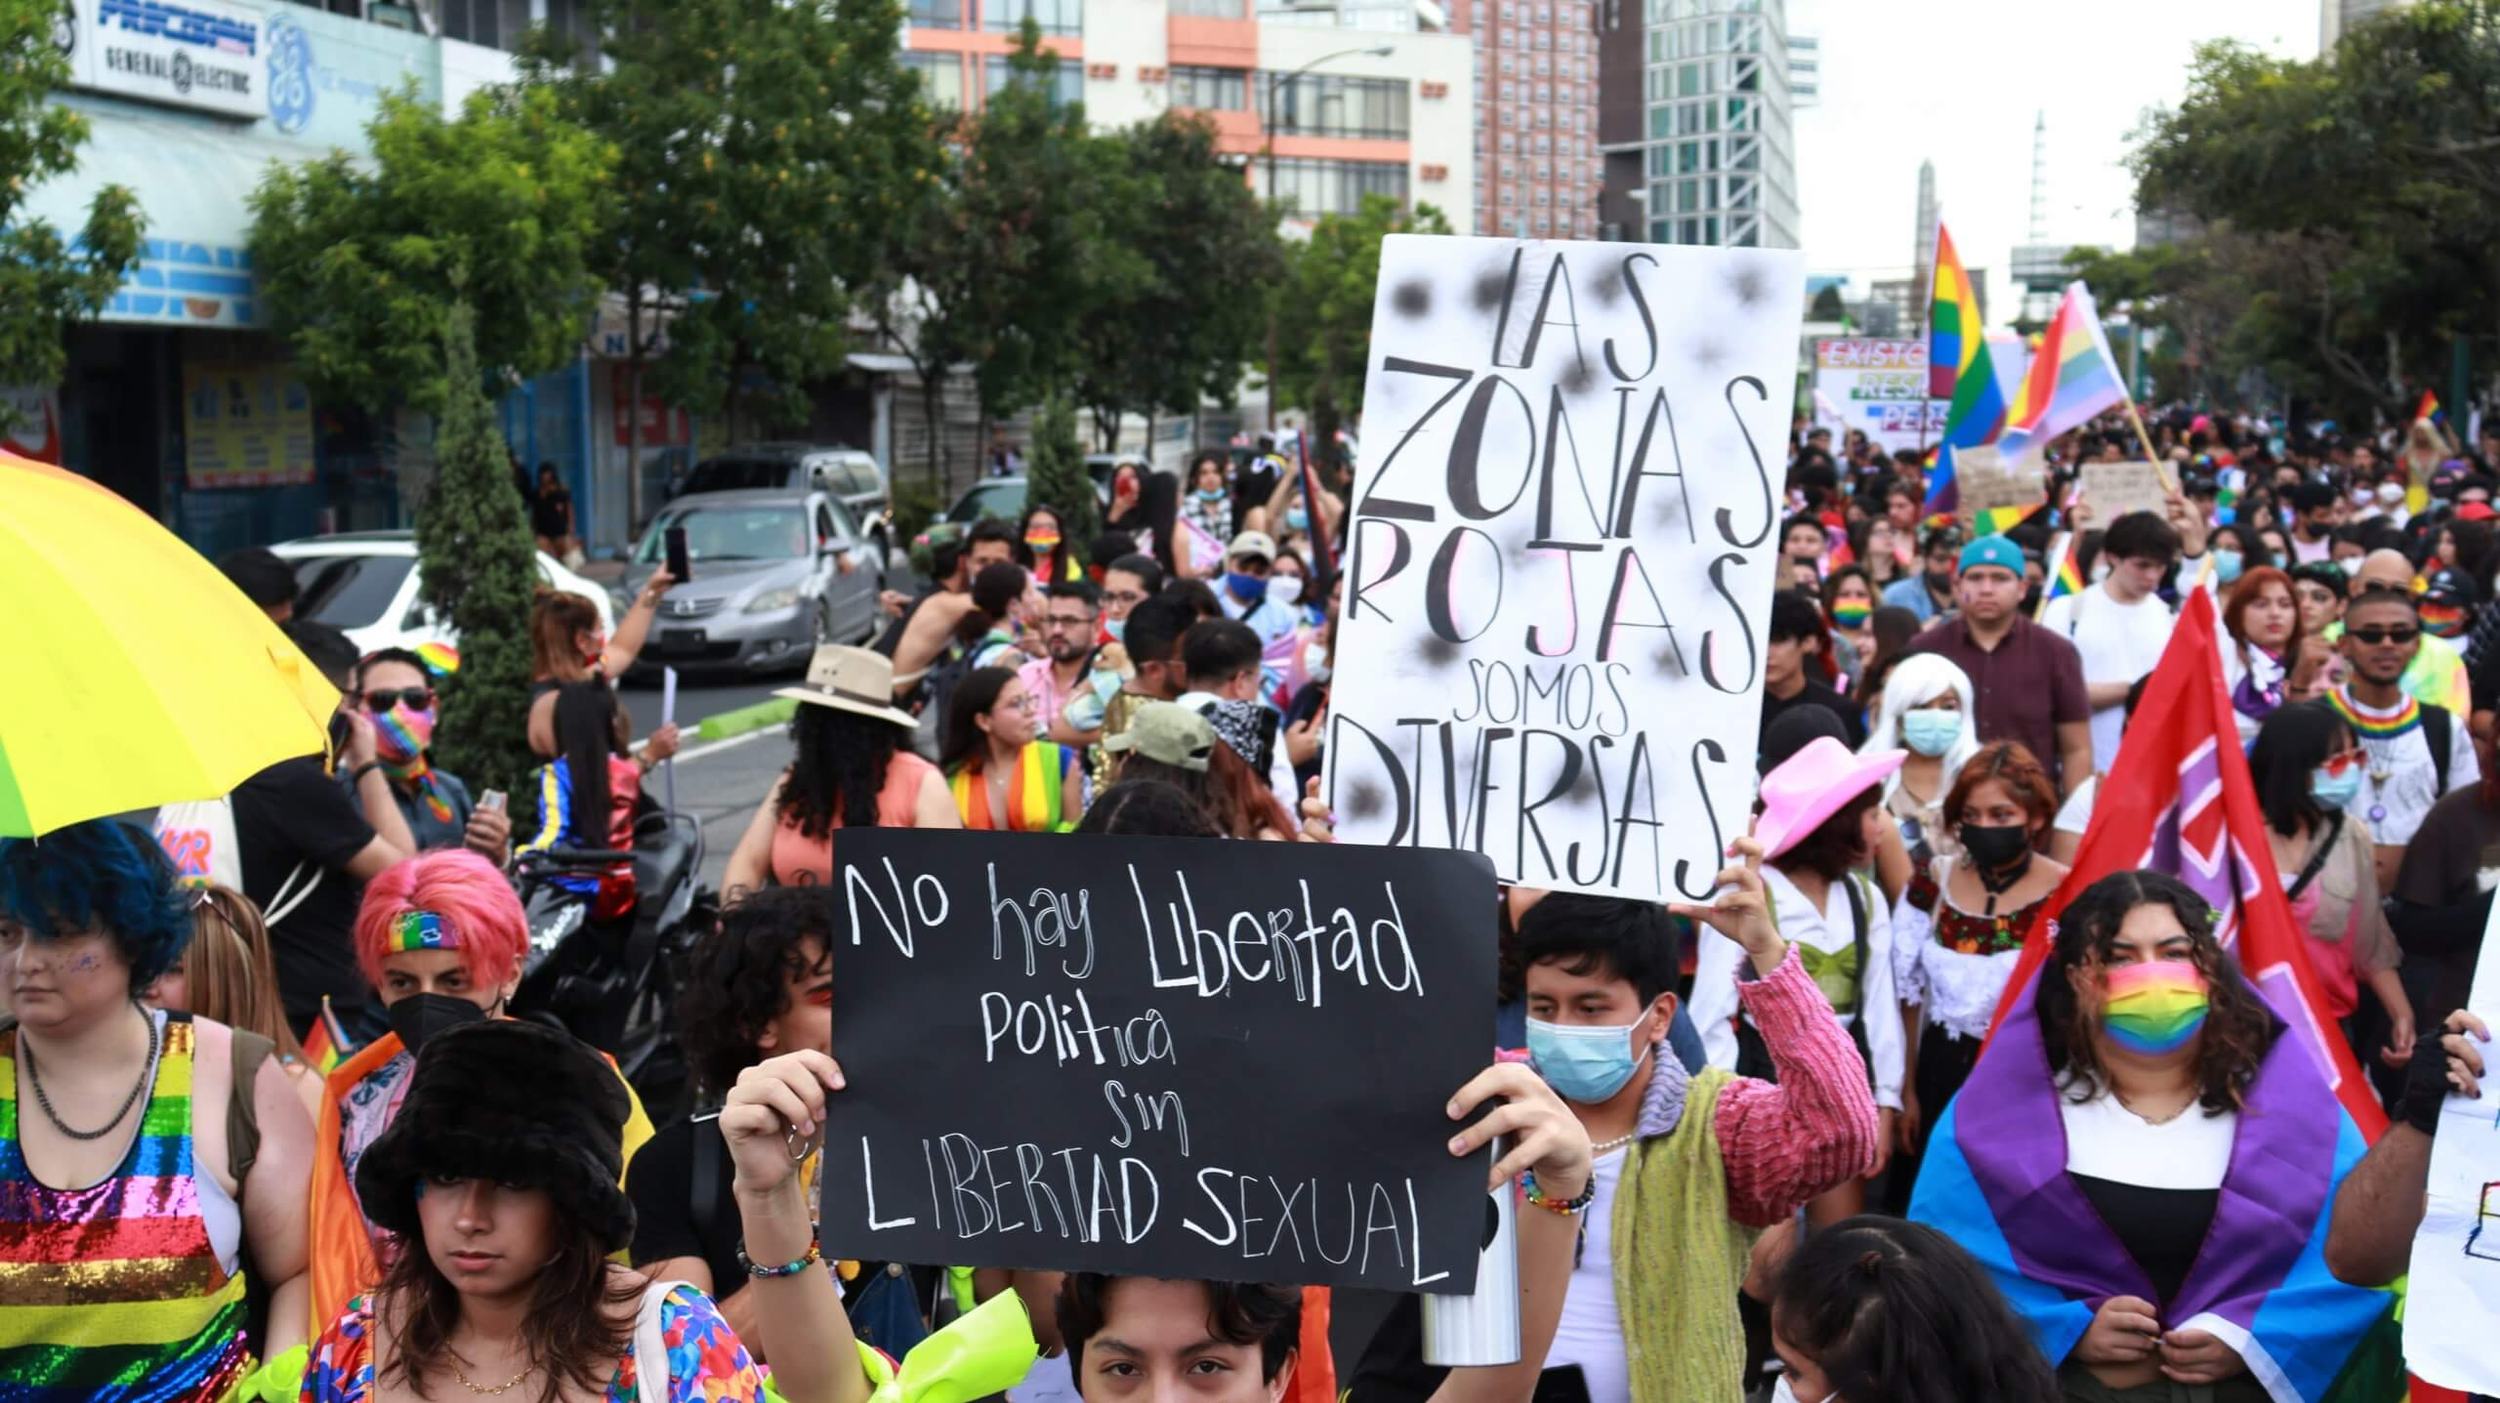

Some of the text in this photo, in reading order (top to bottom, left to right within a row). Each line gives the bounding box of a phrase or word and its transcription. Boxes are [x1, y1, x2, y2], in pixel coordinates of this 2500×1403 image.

[106, 46, 250, 94] GENERAL ELECTRIC
[1356, 356, 1773, 549] ZONAS
[1347, 518, 1757, 694] ROJAS
[1453, 658, 1631, 737] SOMOS
[1328, 713, 1728, 901] DIVERSAS
[844, 857, 949, 958] No
[987, 862, 1096, 979] hay
[862, 1132, 1450, 1285] LIBERTAD SEXUAL
